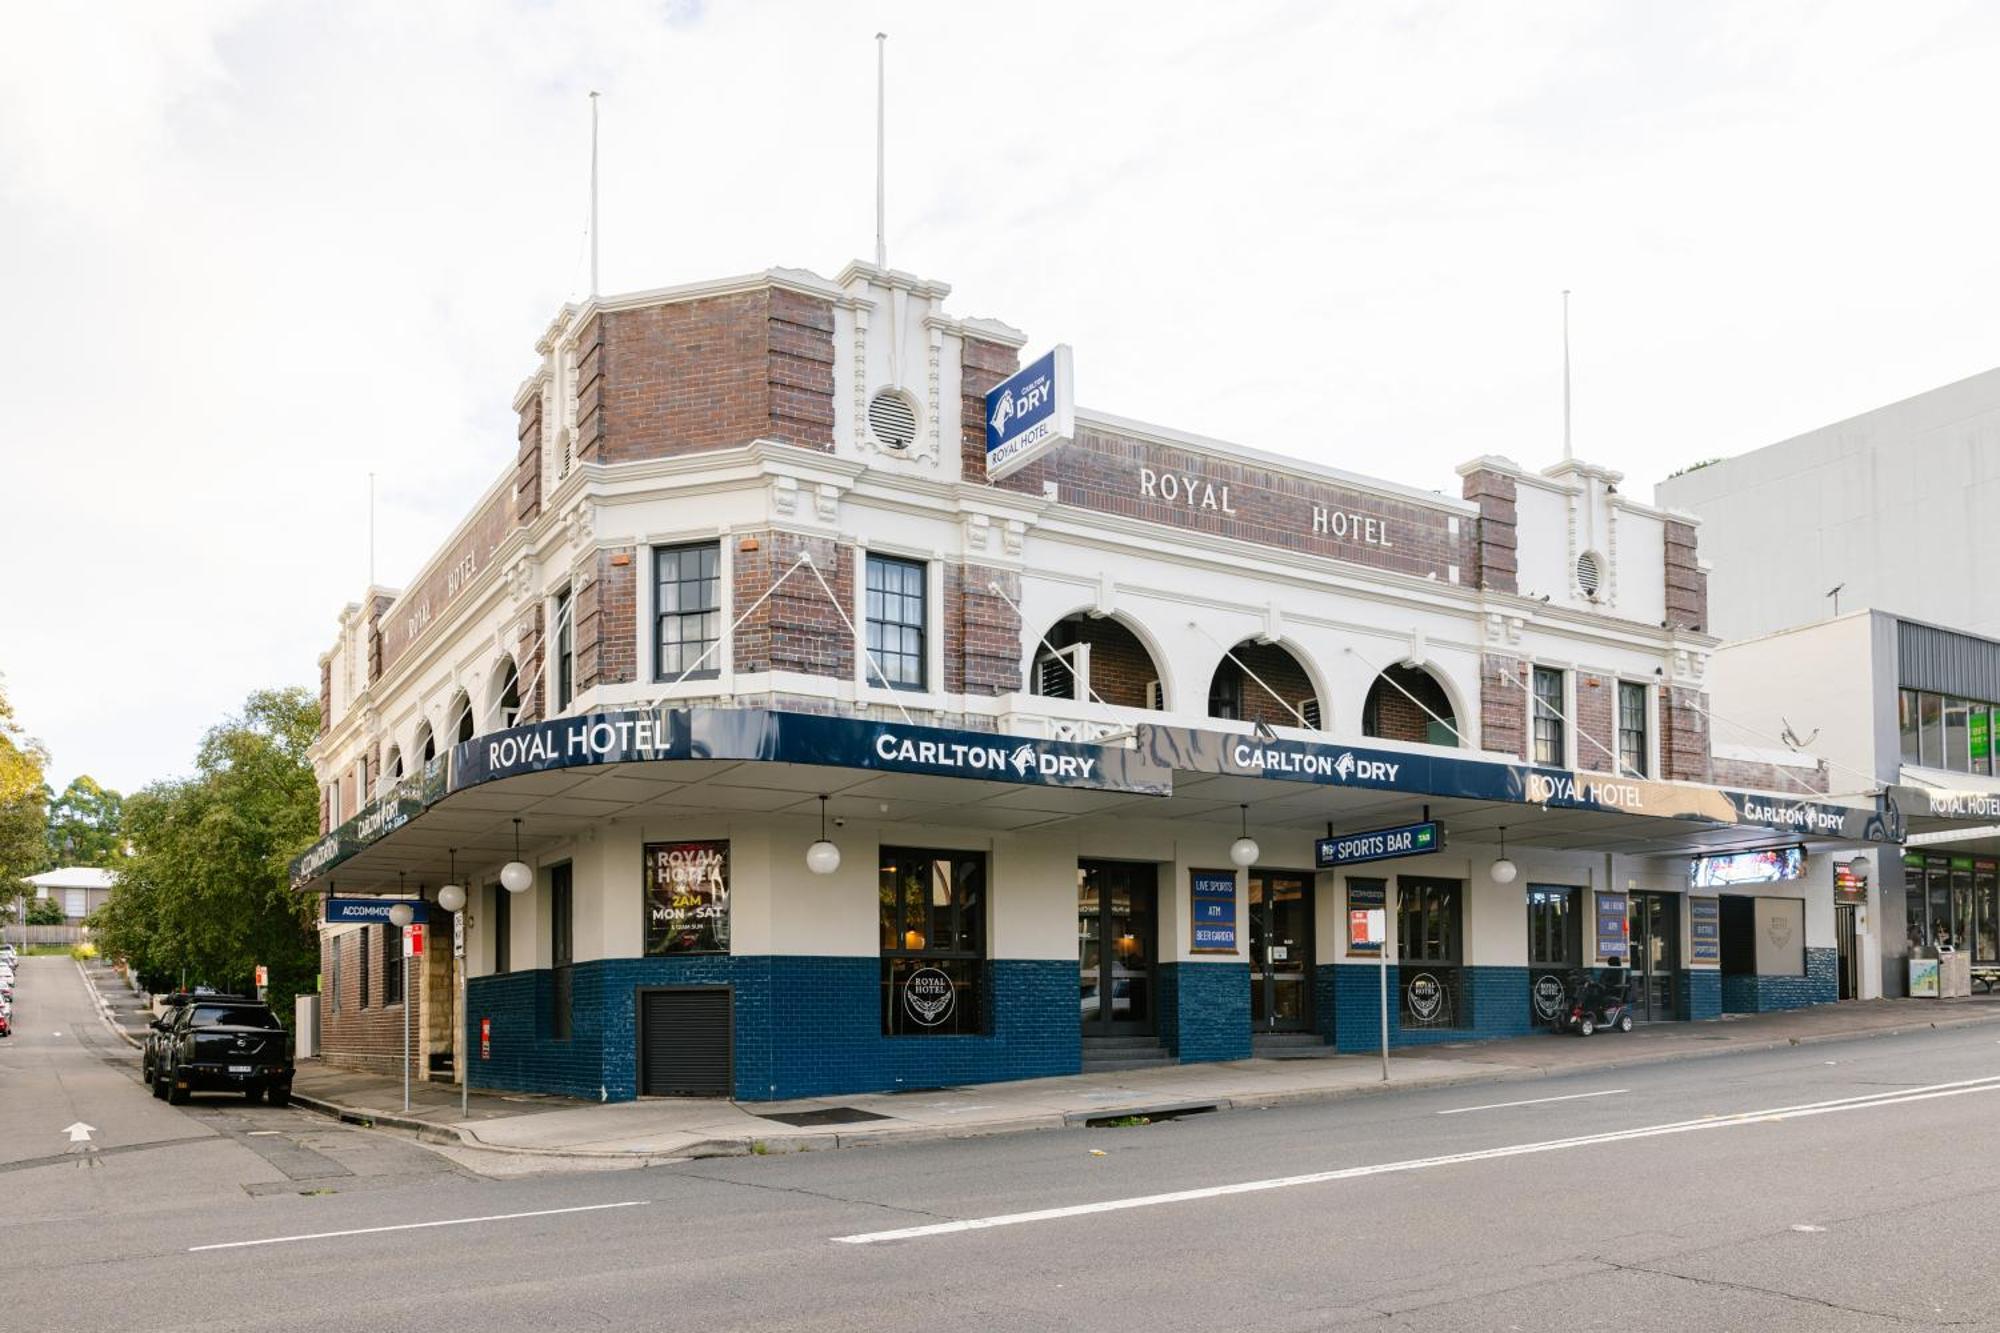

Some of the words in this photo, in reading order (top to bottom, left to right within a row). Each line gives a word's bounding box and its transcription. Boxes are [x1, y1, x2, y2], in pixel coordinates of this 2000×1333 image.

[1020, 374, 1047, 396] CARLTON
[1016, 379, 1051, 419] DRY
[991, 441, 1019, 466] ROYAL
[1020, 423, 1049, 449] HOTEL
[1139, 468, 1237, 515] ROYAL
[1312, 506, 1393, 547] HOTEL
[408, 598, 432, 641] ROYAL
[447, 549, 477, 598] HOTEL
[489, 730, 560, 771] ROYAL
[567, 720, 672, 756] HOTEL
[875, 734, 1006, 771] CARLTON
[1039, 753, 1095, 778] DRY
[1234, 744, 1332, 776] CARLTON
[1356, 760, 1400, 782] DRY
[1529, 773, 1586, 802] ROYAL
[1589, 782, 1643, 808] HOTEL
[1744, 802, 1804, 826] CARLTON
[1818, 813, 1845, 830] DRY
[1930, 795, 1966, 814] ROYAL
[1338, 837, 1384, 859] SPORTS
[1387, 832, 1412, 852] BAR
[658, 849, 717, 867] ROYAL
[1195, 880, 1210, 892] LIVE
[1210, 881, 1233, 892] SPORTS
[652, 908, 685, 921] MON
[696, 906, 722, 918] SAT
[672, 895, 702, 908] 2AM
[1208, 905, 1221, 917] ATM
[1196, 929, 1211, 941] BEER
[915, 977, 946, 986] ROYAL
[915, 985, 946, 994] HOTEL
